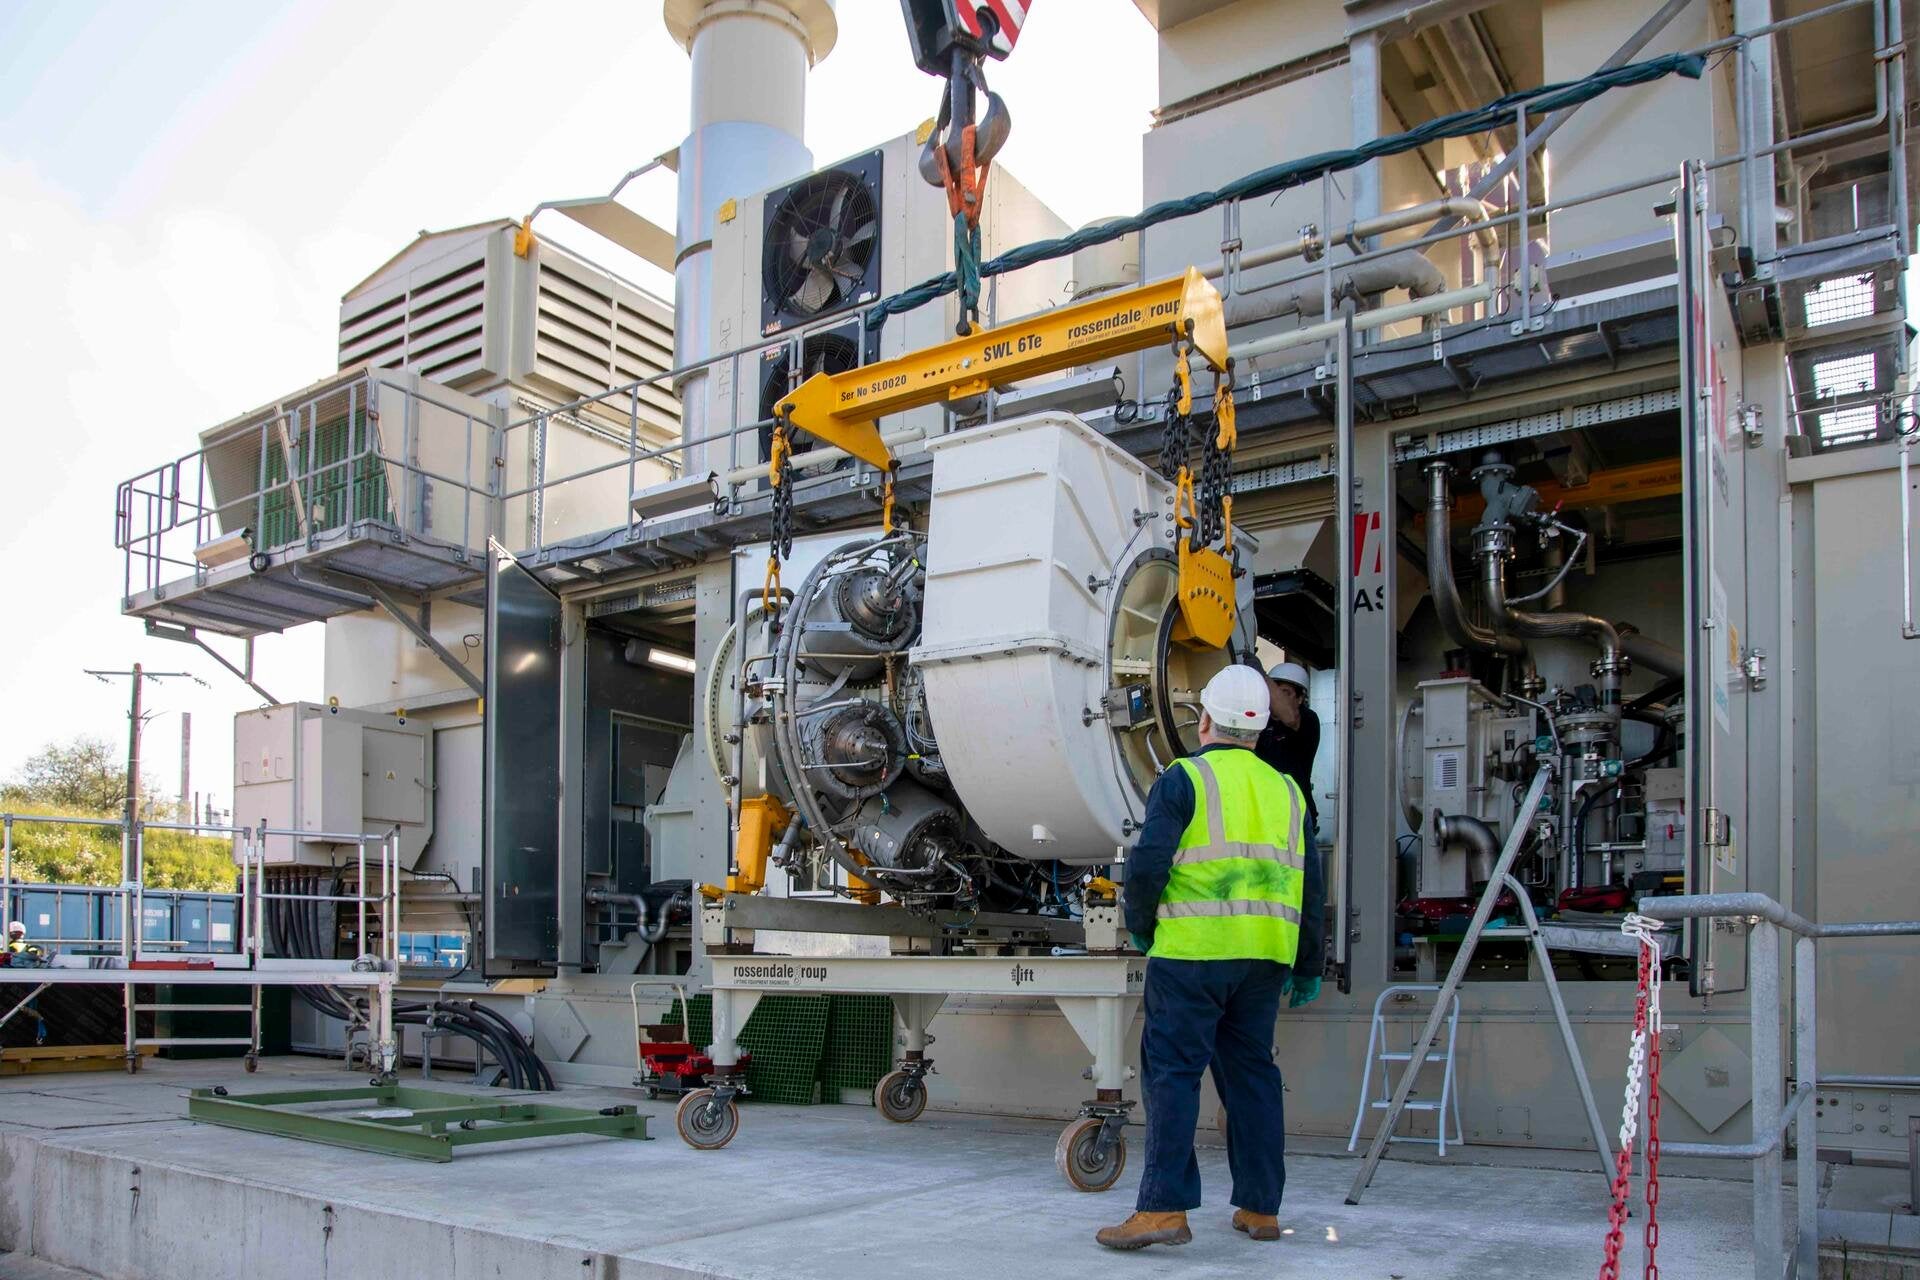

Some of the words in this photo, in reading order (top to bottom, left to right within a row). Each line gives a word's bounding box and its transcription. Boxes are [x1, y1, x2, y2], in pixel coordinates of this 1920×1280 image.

[1068, 309, 1141, 339] rossendale
[984, 341, 1014, 362] SWL
[1017, 333, 1042, 353] 6Te
[841, 389, 854, 402] Ser
[856, 386, 868, 397] No
[871, 374, 907, 394] SL0020
[734, 964, 794, 978] rossendale
[1134, 971, 1144, 983] No
